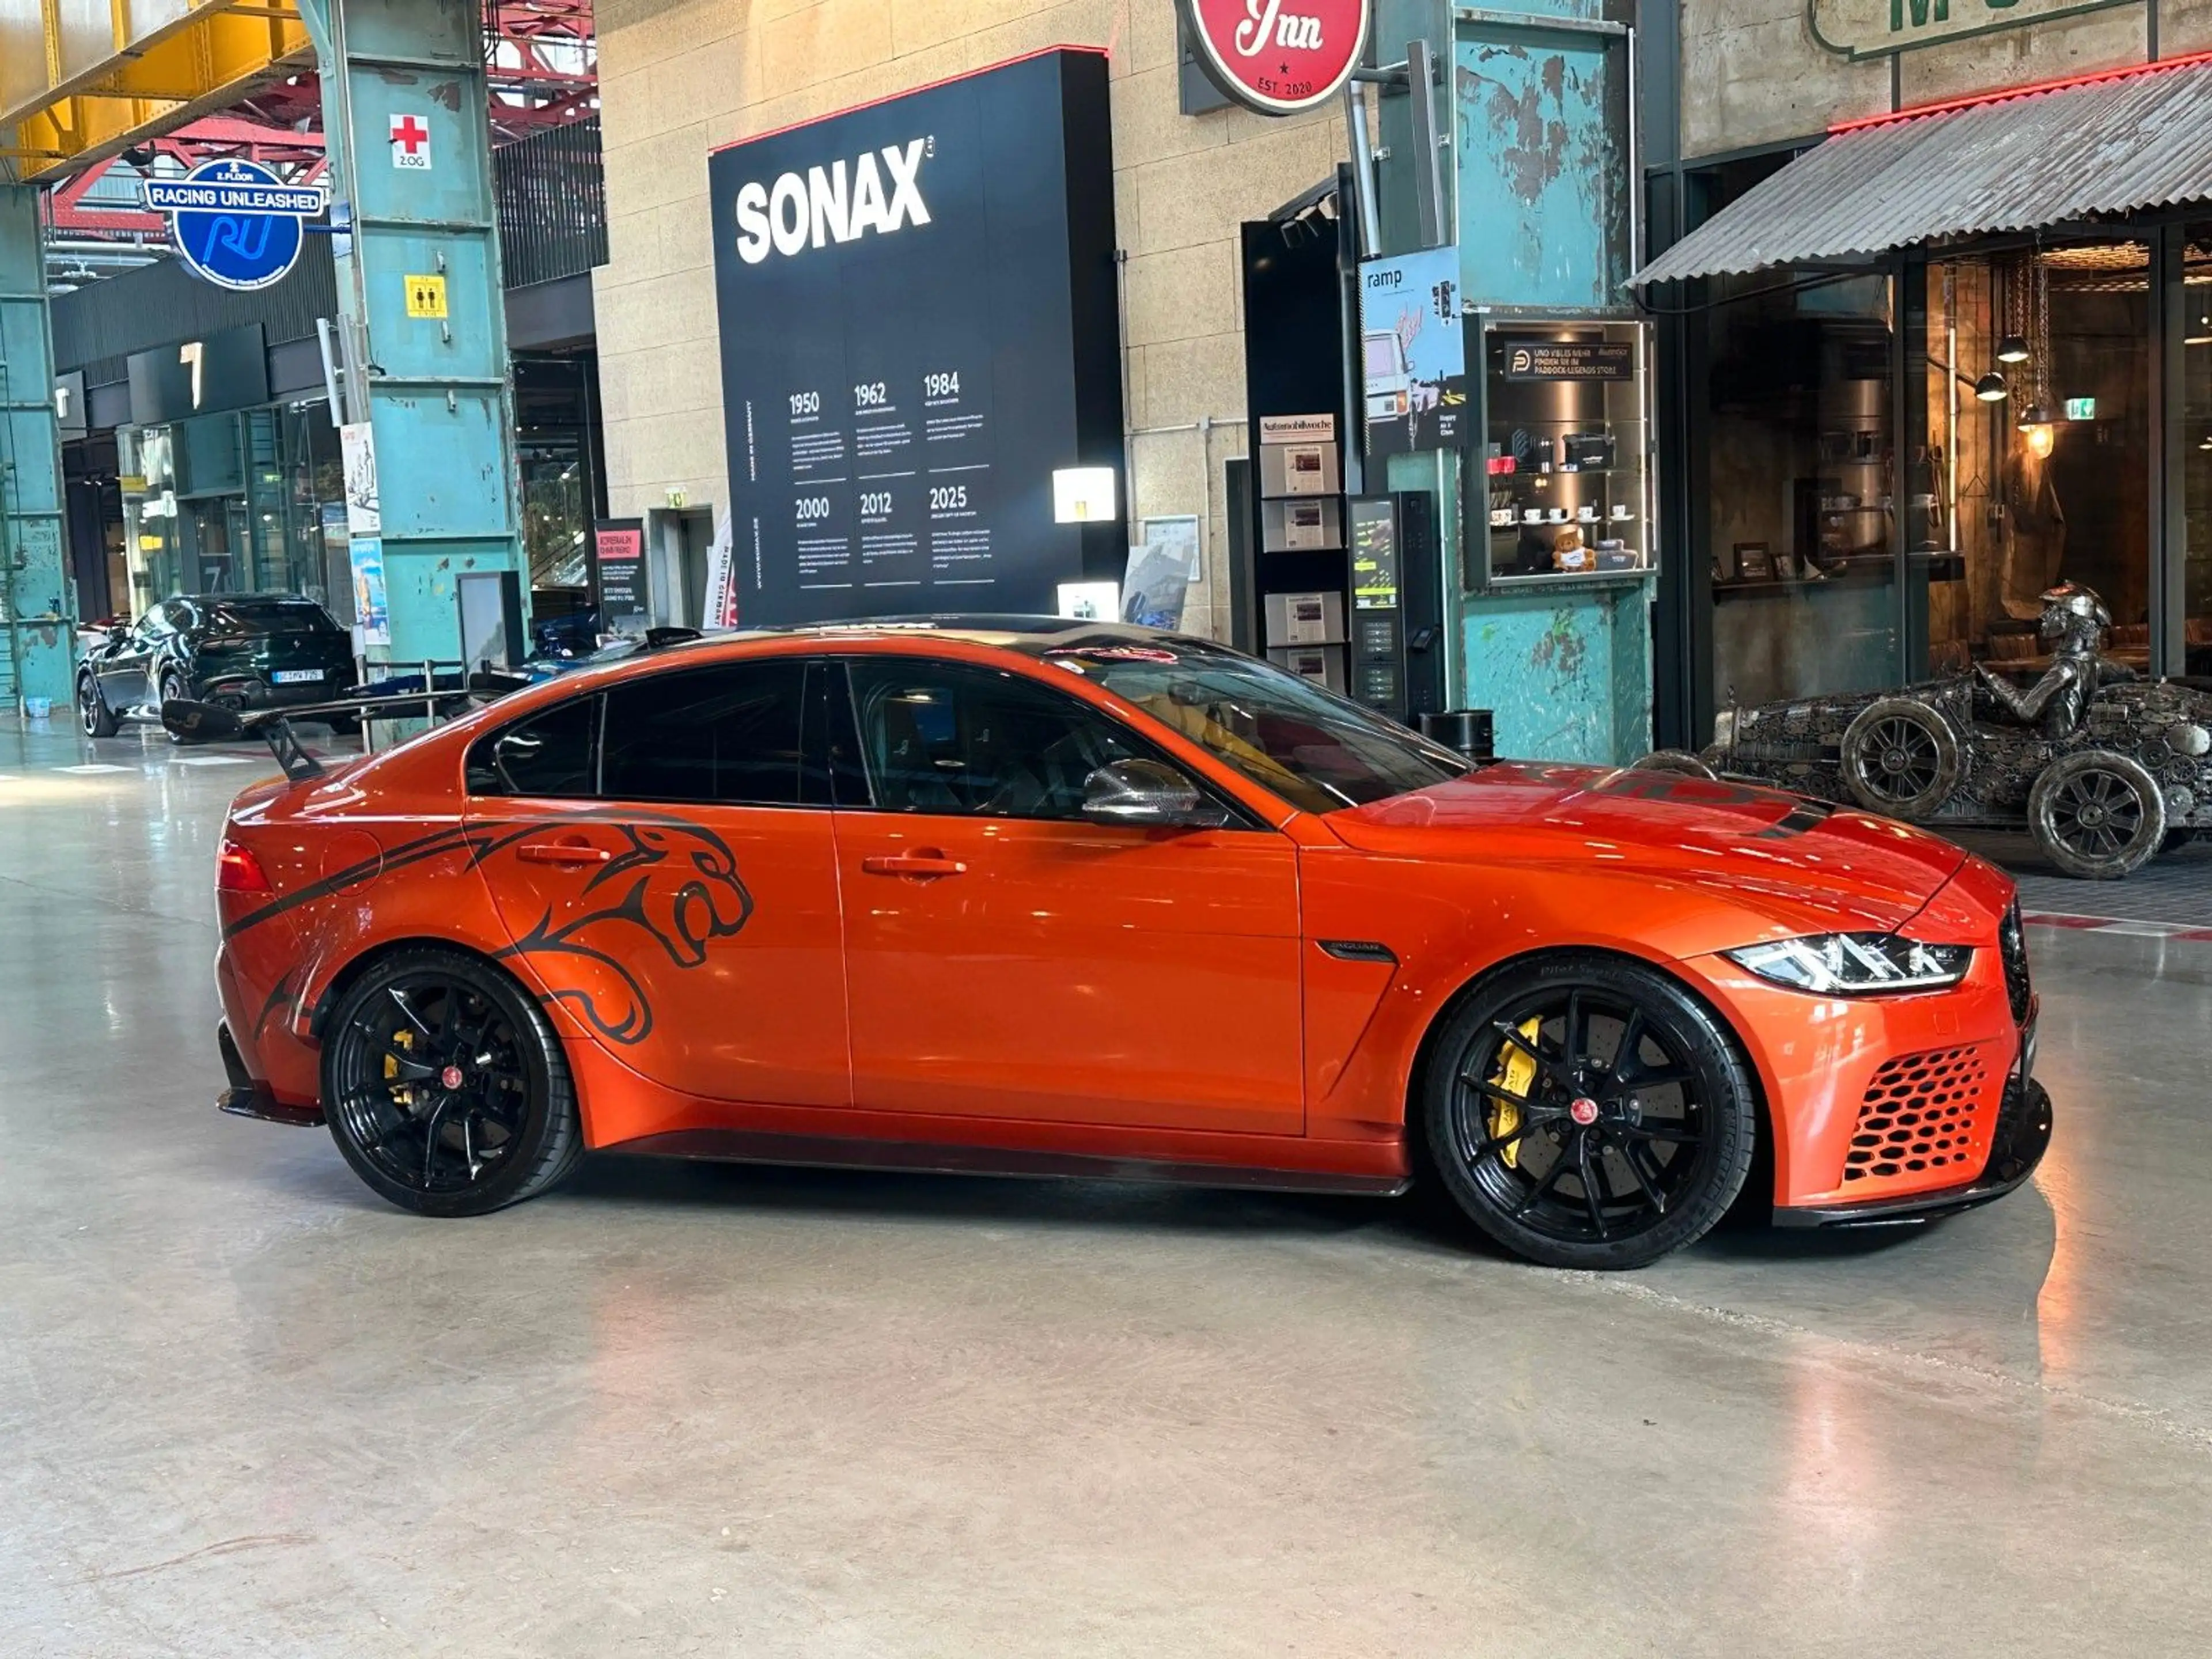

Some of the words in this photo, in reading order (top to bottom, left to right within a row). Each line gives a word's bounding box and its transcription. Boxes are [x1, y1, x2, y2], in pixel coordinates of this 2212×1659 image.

[1286, 81, 1312, 94] 2020
[151, 188, 216, 204] RACING
[220, 191, 319, 209] UNLEASHED
[736, 138, 931, 264] SONAX
[1368, 270, 1402, 288] ramp
[855, 382, 887, 406] 1962
[925, 372, 960, 396] 1984
[790, 391, 819, 414] 1950
[796, 499, 830, 519] 2000
[860, 492, 892, 514] 2012
[929, 486, 967, 510] 2025
